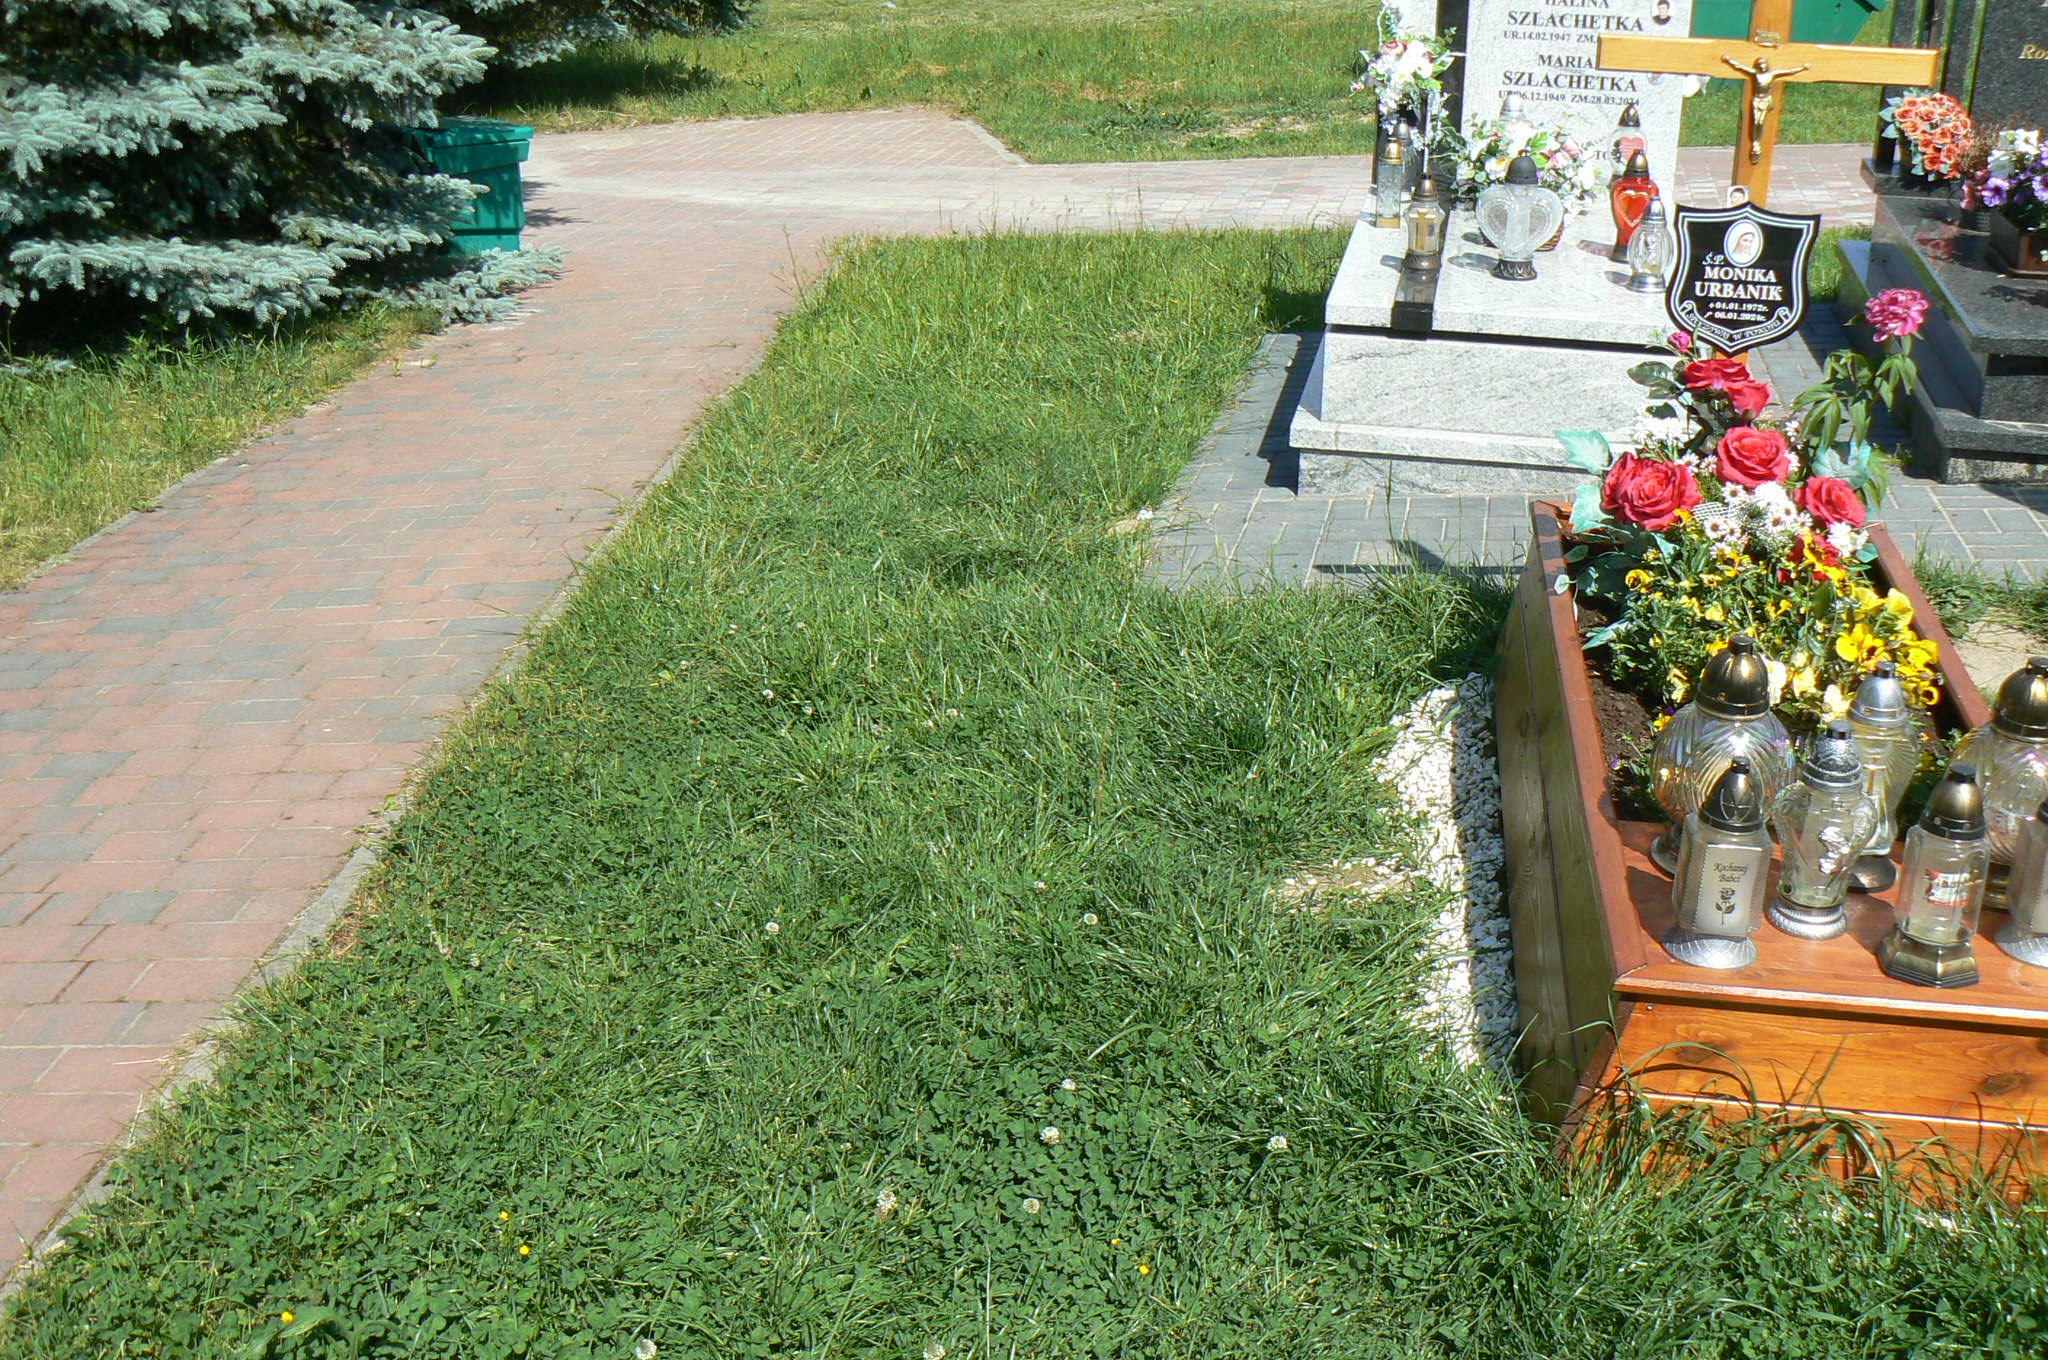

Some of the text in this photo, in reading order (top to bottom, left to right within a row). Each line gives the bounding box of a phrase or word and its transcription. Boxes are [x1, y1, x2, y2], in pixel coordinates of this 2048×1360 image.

[1507, 11, 1643, 32] SZLACHETKA
[1537, 54, 1594, 69] MARIA
[1502, 71, 1637, 92] SZLACHETKA
[1704, 266, 1777, 282] MONIKA
[1694, 280, 1784, 301] URBANIK
